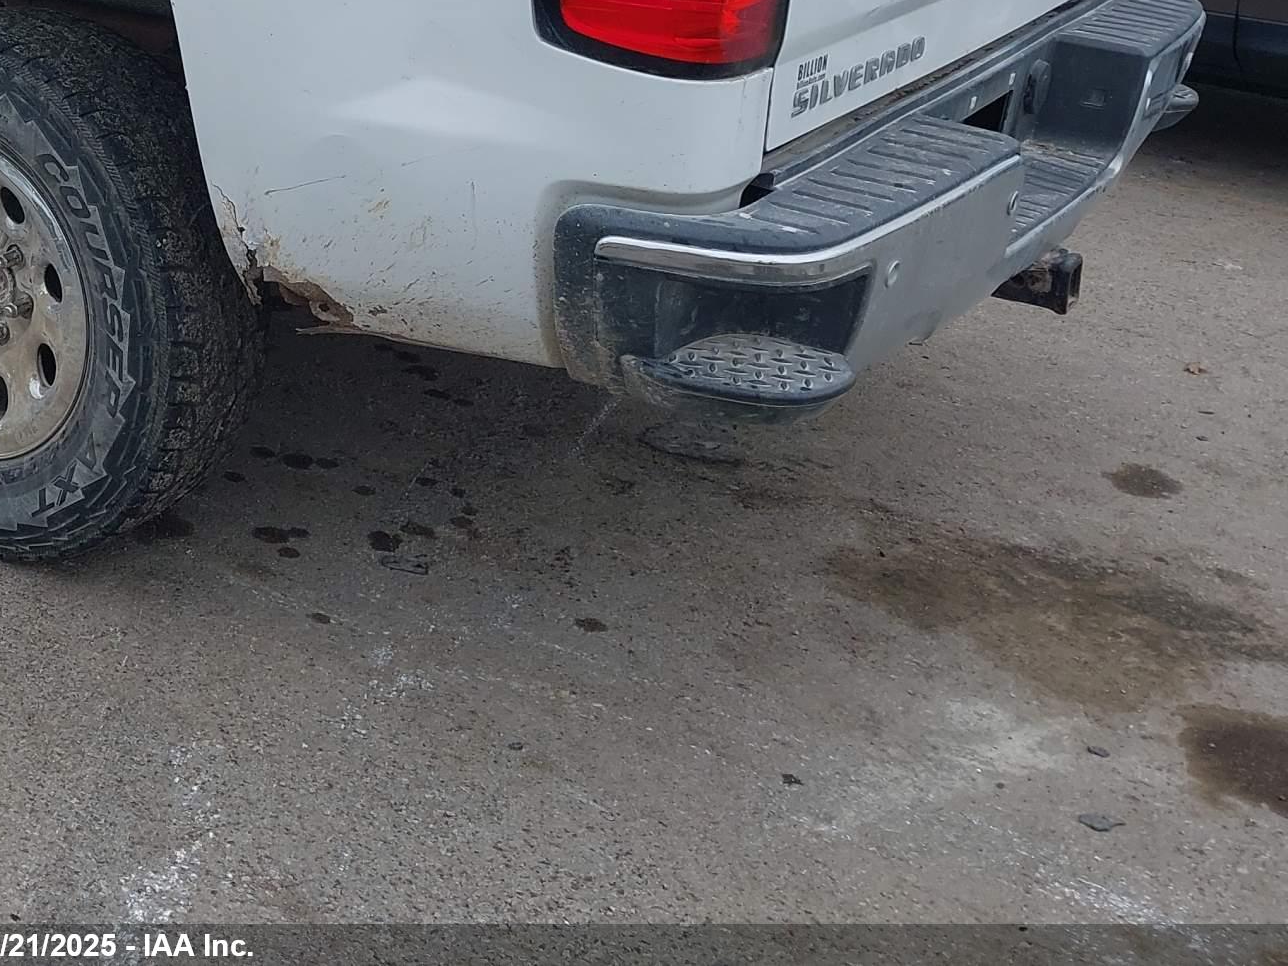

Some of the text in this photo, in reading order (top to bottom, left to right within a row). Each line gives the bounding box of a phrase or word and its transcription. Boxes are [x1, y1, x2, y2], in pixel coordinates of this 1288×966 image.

[791, 36, 926, 118] SILVERADO
[797, 53, 829, 81] BILLION
[29, 152, 126, 519] COURSER AXT
